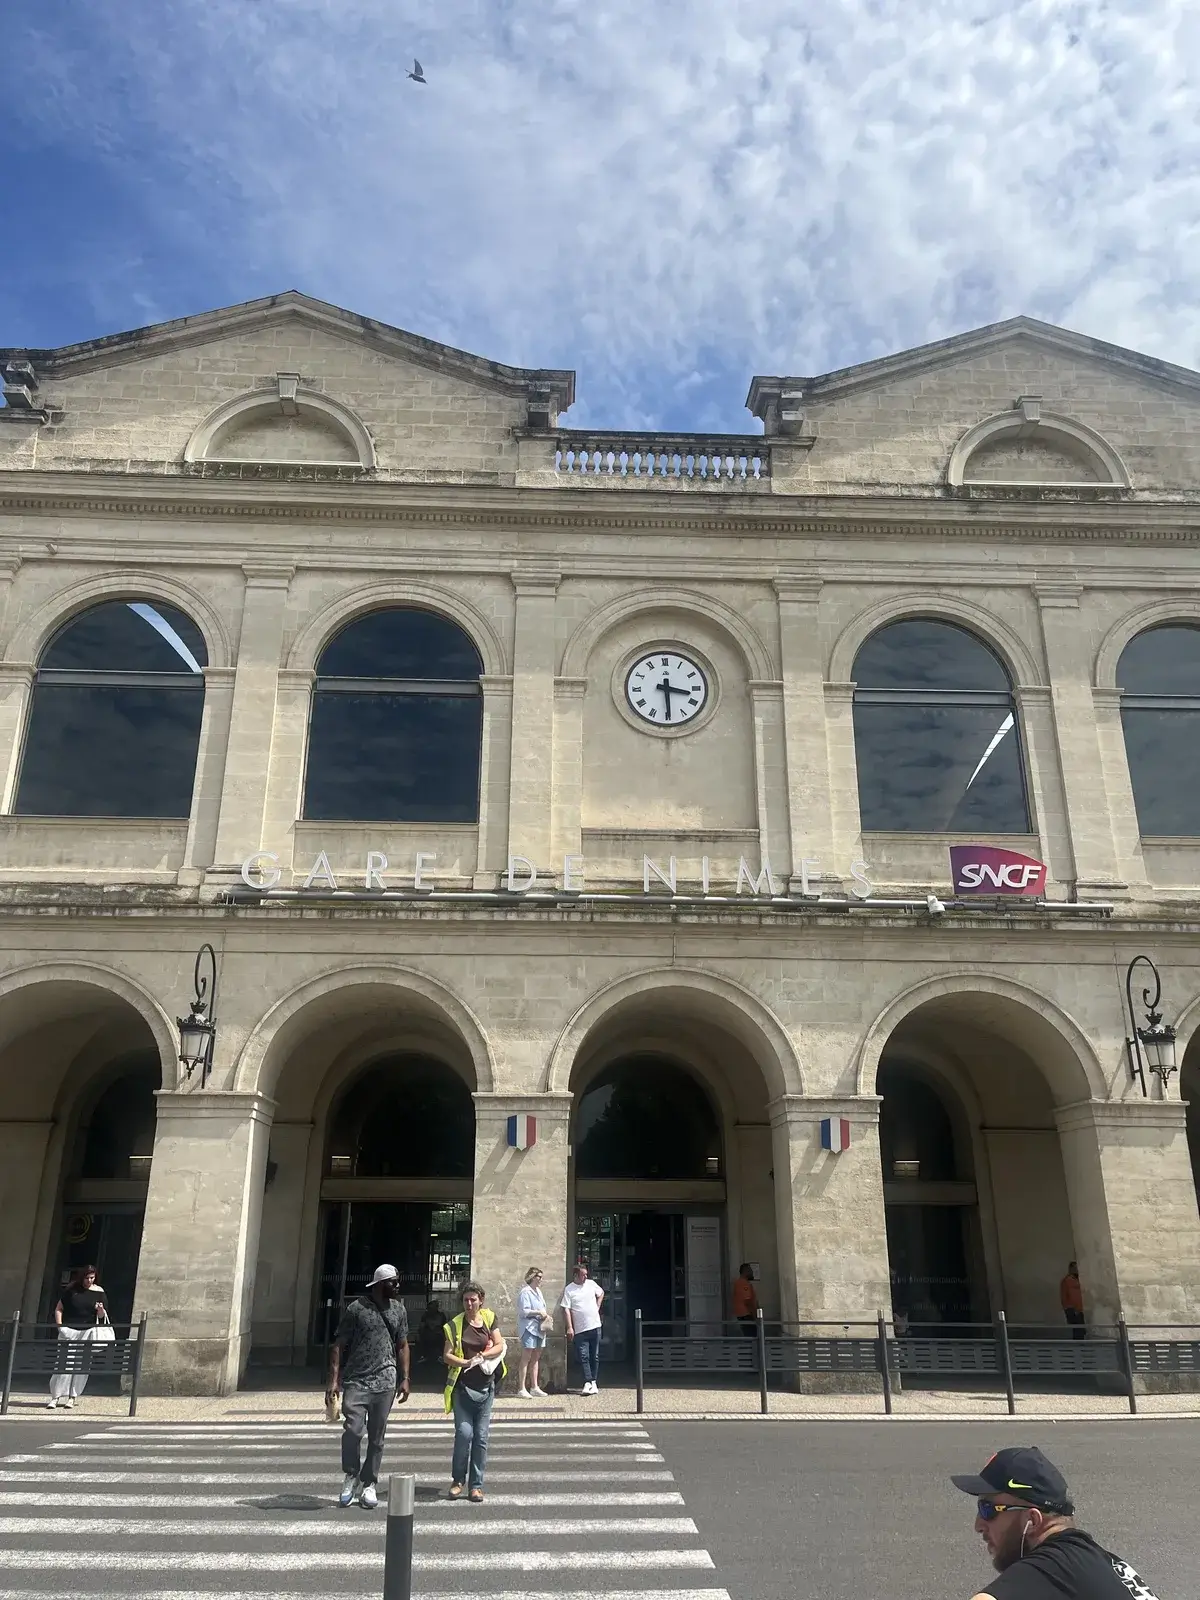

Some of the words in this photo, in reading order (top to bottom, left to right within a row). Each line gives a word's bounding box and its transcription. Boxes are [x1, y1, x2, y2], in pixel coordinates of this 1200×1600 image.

[241, 849, 437, 893] GARE
[507, 853, 585, 892] DE
[643, 853, 874, 898] NIMES
[957, 863, 1042, 889] SNCF
